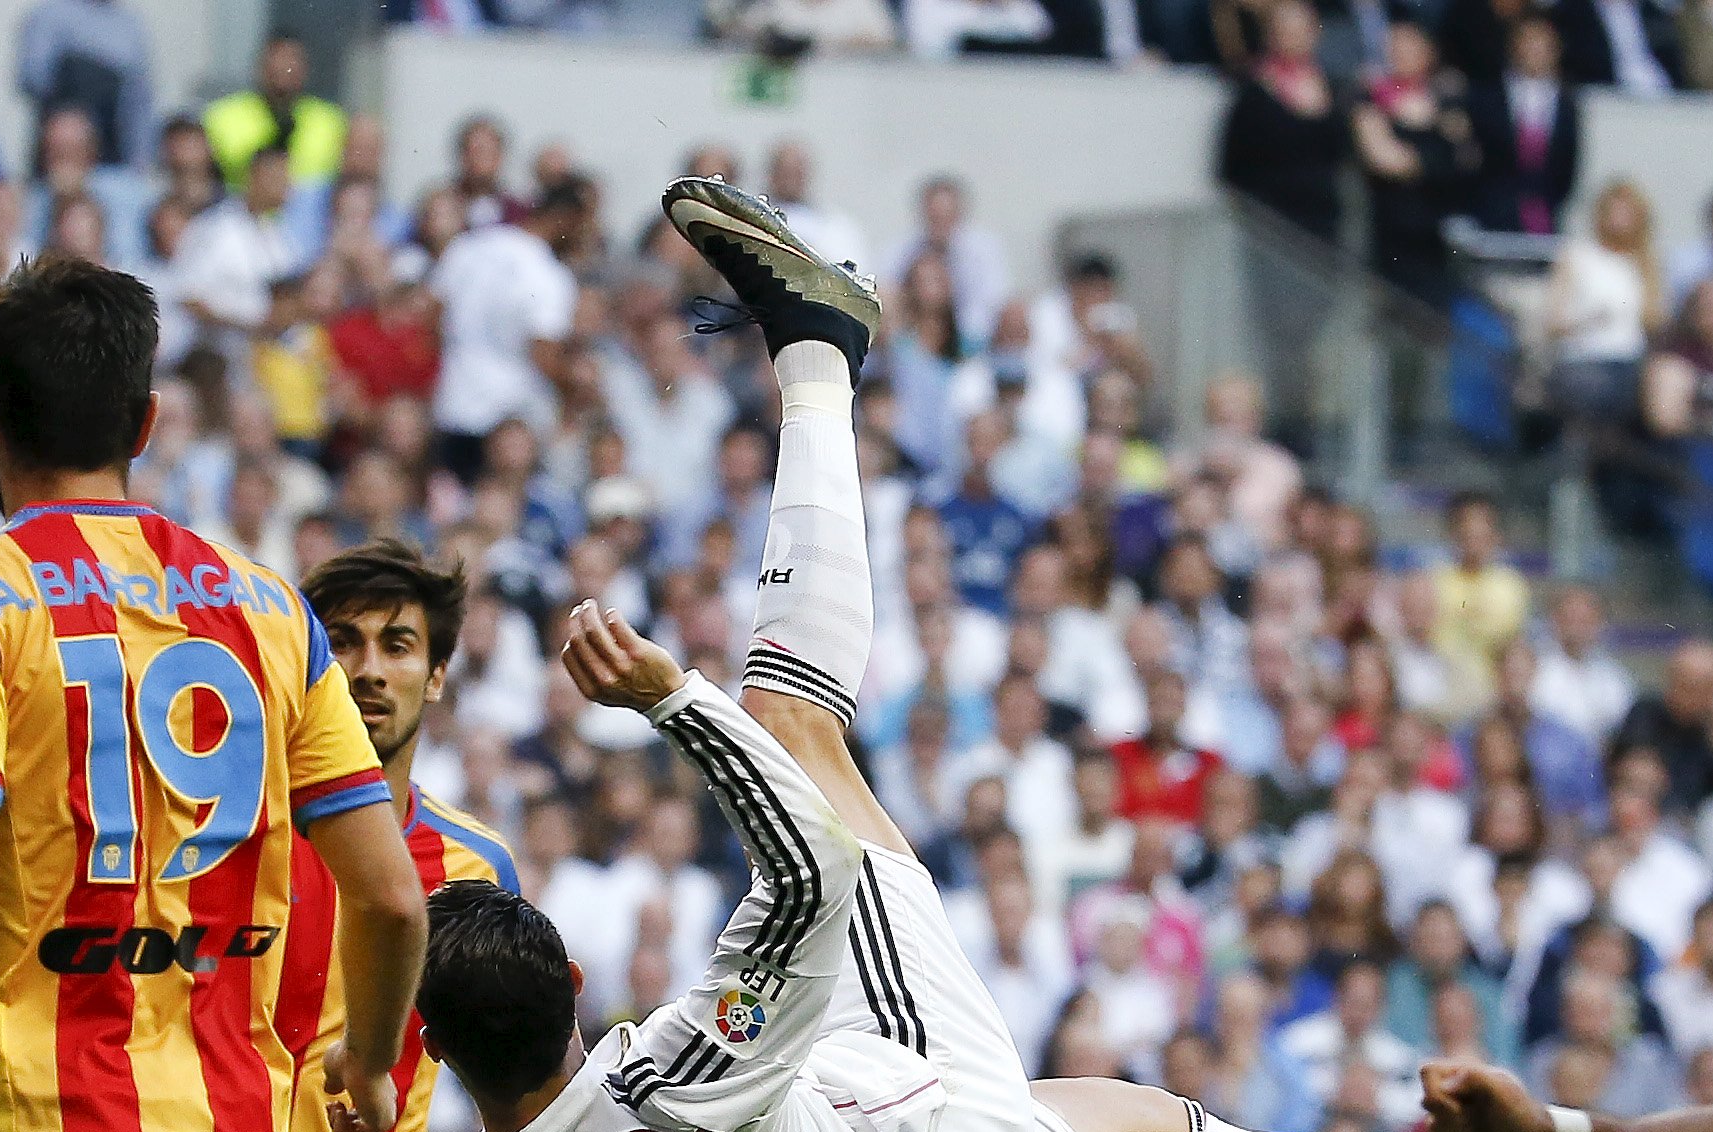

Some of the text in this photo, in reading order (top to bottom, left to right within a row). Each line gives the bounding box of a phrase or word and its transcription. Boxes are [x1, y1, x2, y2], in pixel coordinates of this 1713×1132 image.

[30, 557, 292, 616] BARRAGAN
[55, 633, 267, 883] 19
[739, 961, 787, 1002] LFP
